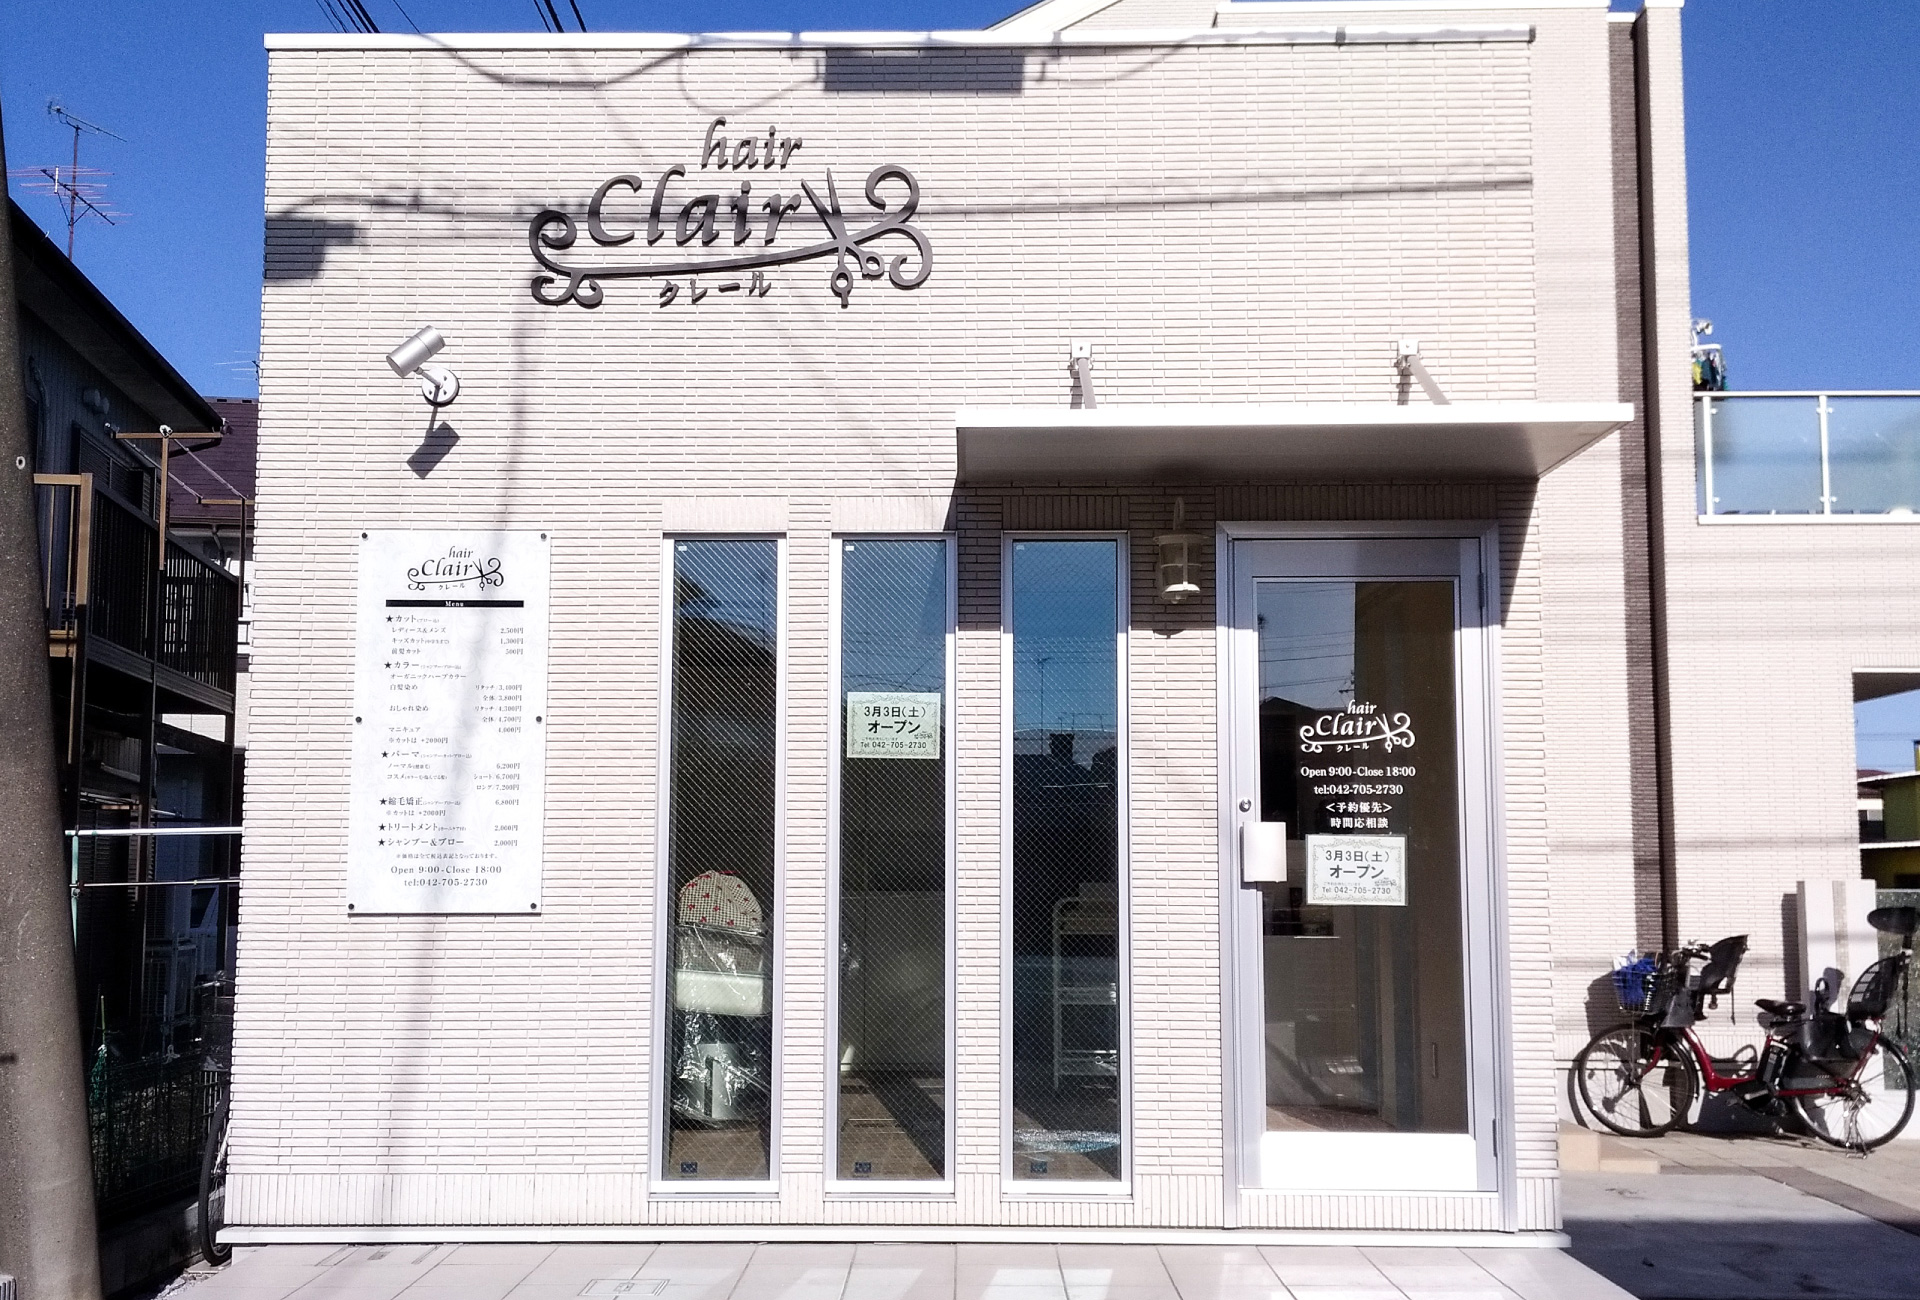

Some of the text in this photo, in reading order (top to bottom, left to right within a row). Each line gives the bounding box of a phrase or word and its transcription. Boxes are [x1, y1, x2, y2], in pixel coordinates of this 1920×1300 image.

[701, 116, 803, 171] hair
[587, 164, 801, 246] Clair
[659, 272, 773, 308] クレール
[448, 545, 474, 559] hair
[421, 557, 473, 577] Clair
[864, 706, 926, 718] 3月3日(土)
[1346, 699, 1377, 714] hair
[868, 720, 921, 734] オープン
[1315, 713, 1377, 736] Clair
[871, 741, 927, 749] 042-705-2730
[1336, 741, 1370, 753] クレール
[1300, 767, 1327, 778] Open
[1386, 767, 1416, 776] 18:00
[1314, 783, 1403, 794] tel:042-705-2730
[388, 796, 423, 806] 縮毛矯正
[1326, 801, 1392, 813] <予約優先>
[388, 822, 438, 831] トリートメント
[1330, 817, 1388, 828] 時間応相談
[388, 837, 464, 846] シャンプー&ブロー
[1326, 850, 1389, 863] 3月3日(土)
[391, 866, 414, 875] Open
[1329, 864, 1384, 879] オープン
[404, 878, 488, 887] tel:042-705-2730
[1334, 886, 1391, 894] 042-705-2730
